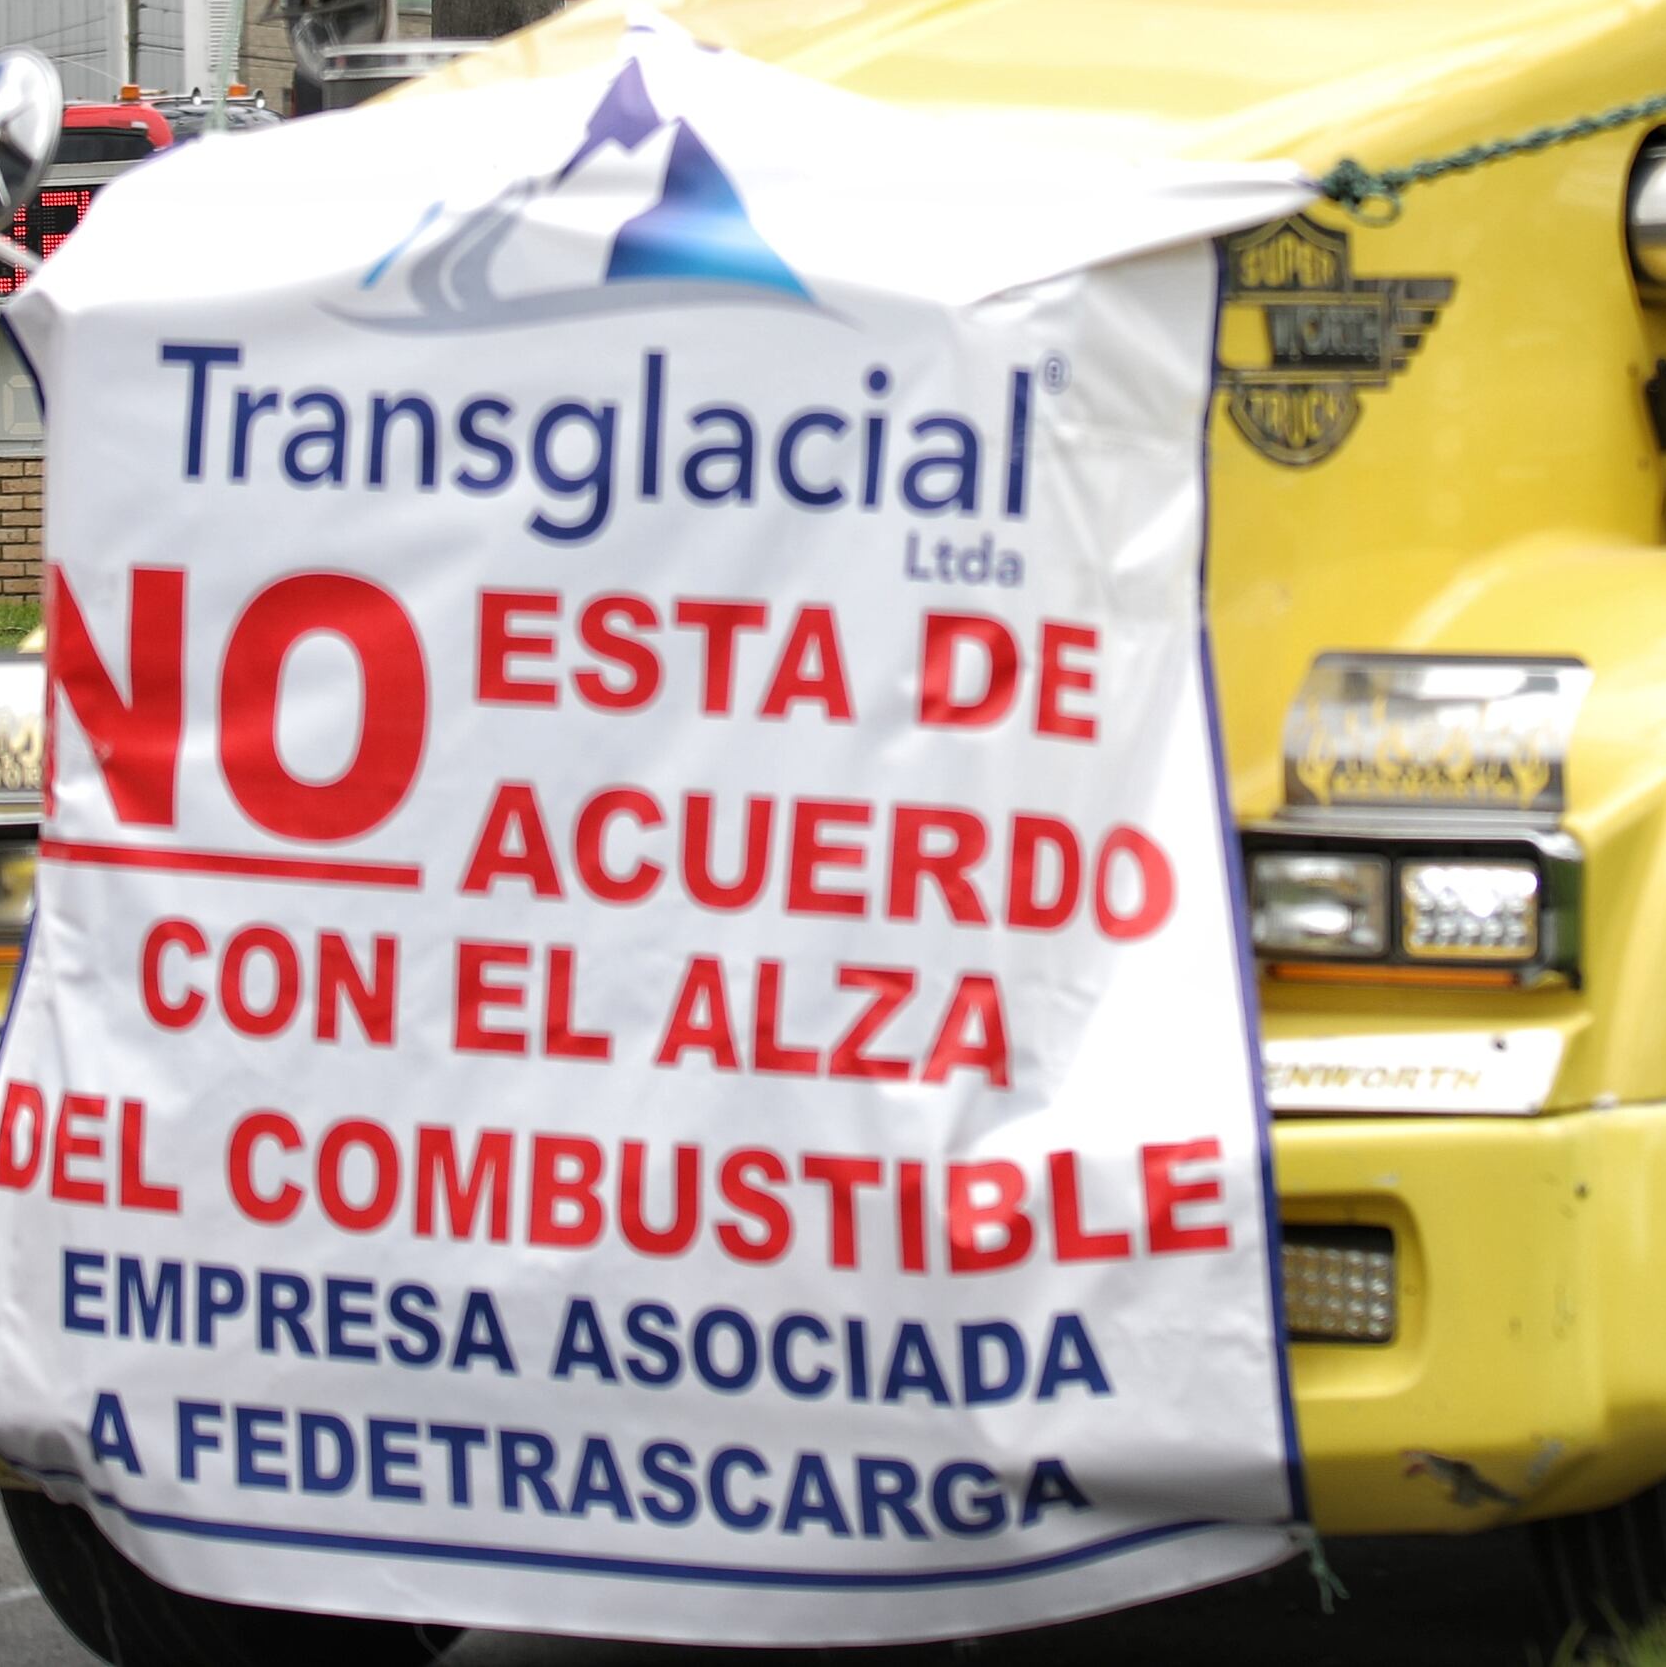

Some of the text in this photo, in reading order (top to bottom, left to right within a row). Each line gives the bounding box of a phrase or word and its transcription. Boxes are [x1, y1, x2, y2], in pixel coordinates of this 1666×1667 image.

[159, 343, 1030, 540] Transglacial
[906, 535, 1024, 586] Ltda
[43, 564, 430, 844] NO
[477, 589, 1097, 740] ESTA DE
[462, 784, 1177, 940] ACUERDO
[141, 919, 1012, 1088] CON EL ALZA
[227, 1112, 1230, 1274] COMBUSTIBLE
[62, 1249, 1112, 1405] EMPRESA ASOCIADA
[87, 1393, 1090, 1537] A FEDETRASCARGA
